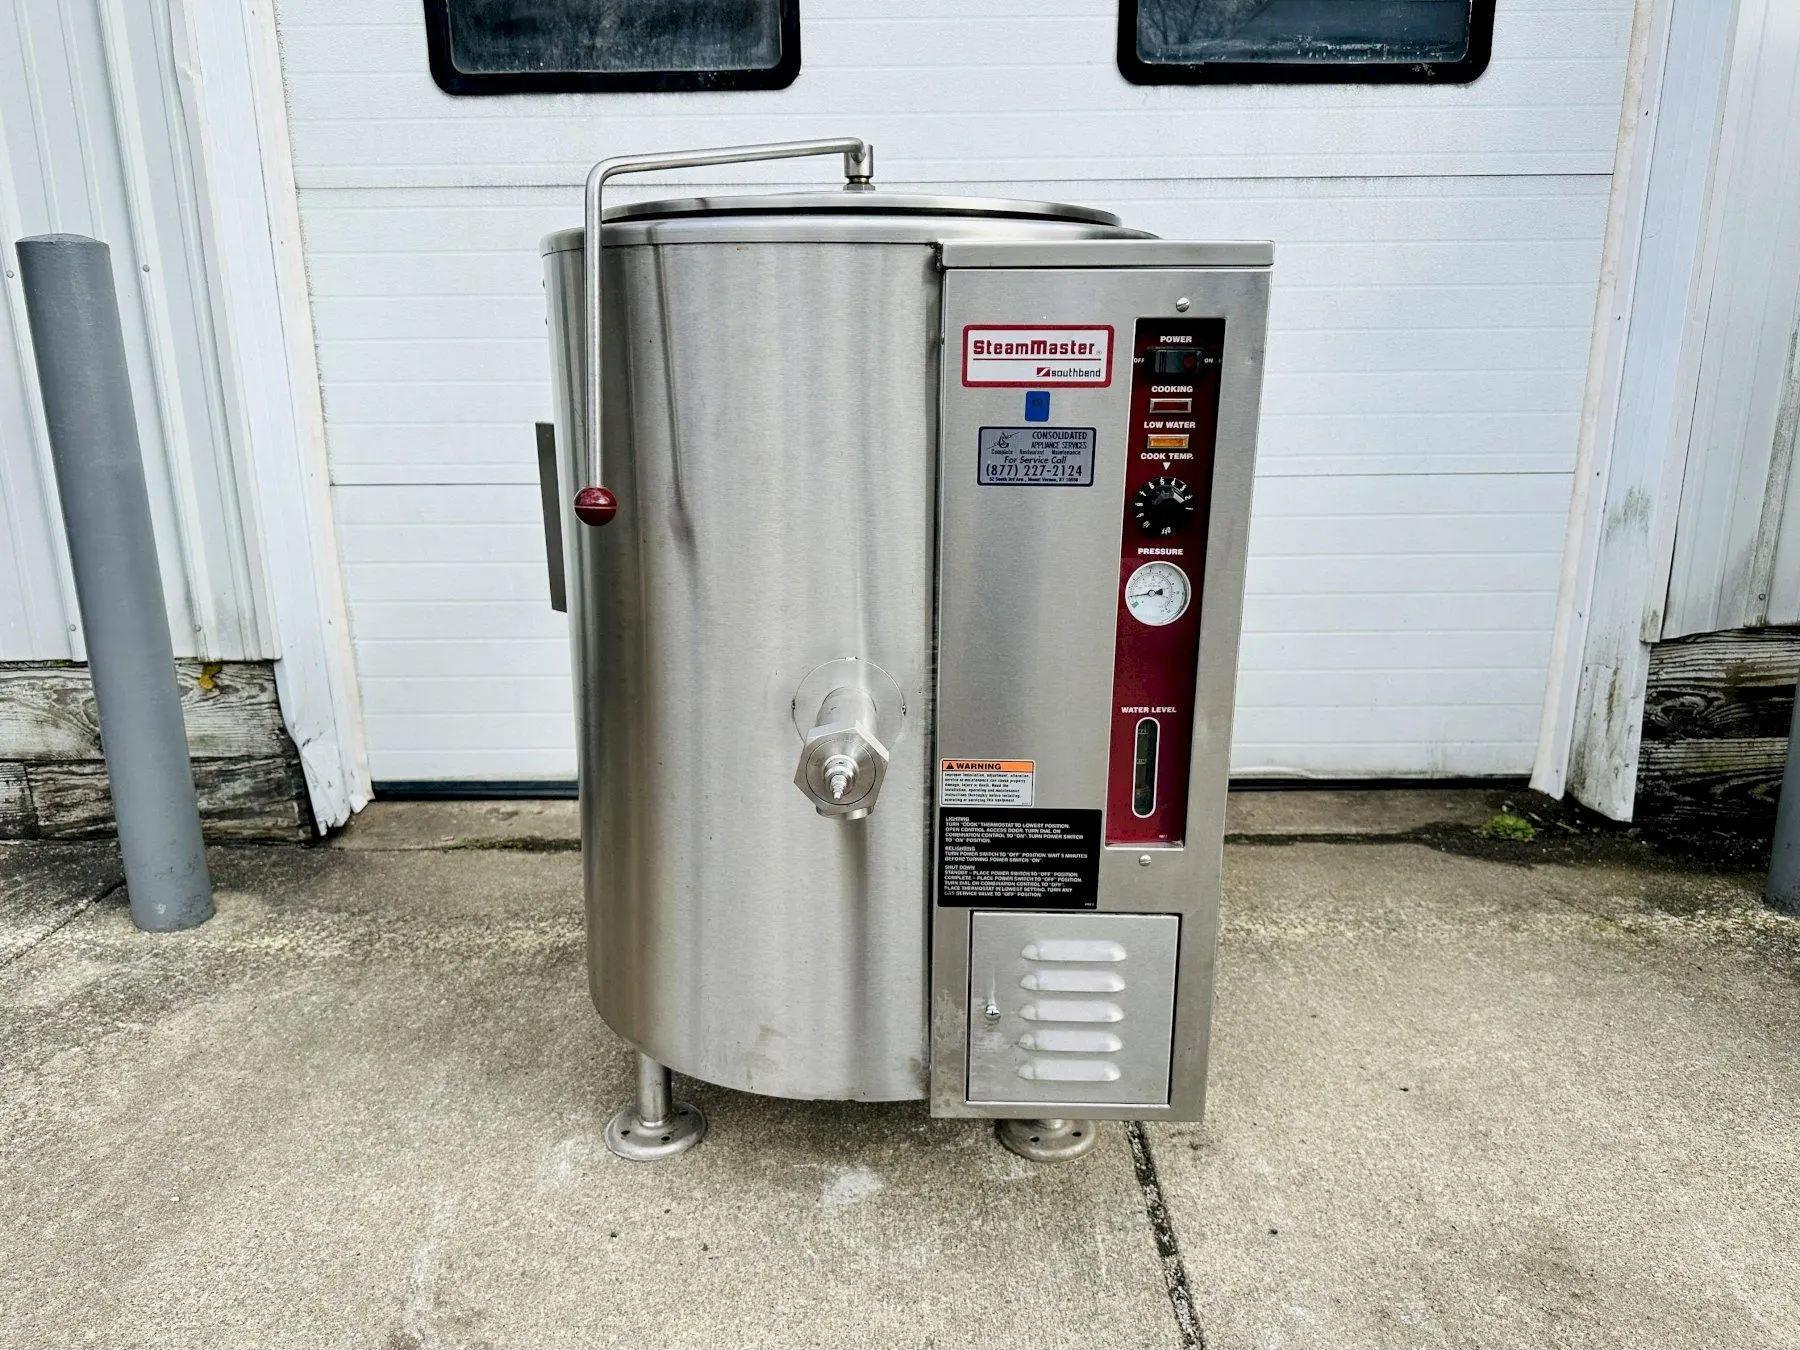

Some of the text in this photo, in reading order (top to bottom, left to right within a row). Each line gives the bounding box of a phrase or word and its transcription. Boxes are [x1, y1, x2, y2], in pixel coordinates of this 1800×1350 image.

[973, 340, 1095, 354] SteamMaster
[1052, 368, 1101, 377] southbend
[1032, 432, 1087, 440] CONSOLIDATED
[1004, 456, 1066, 464] For Service Call
[986, 465, 1082, 476] (877) 227-2124
[1148, 481, 1155, 489] 6
[1171, 478, 1176, 486] 4
